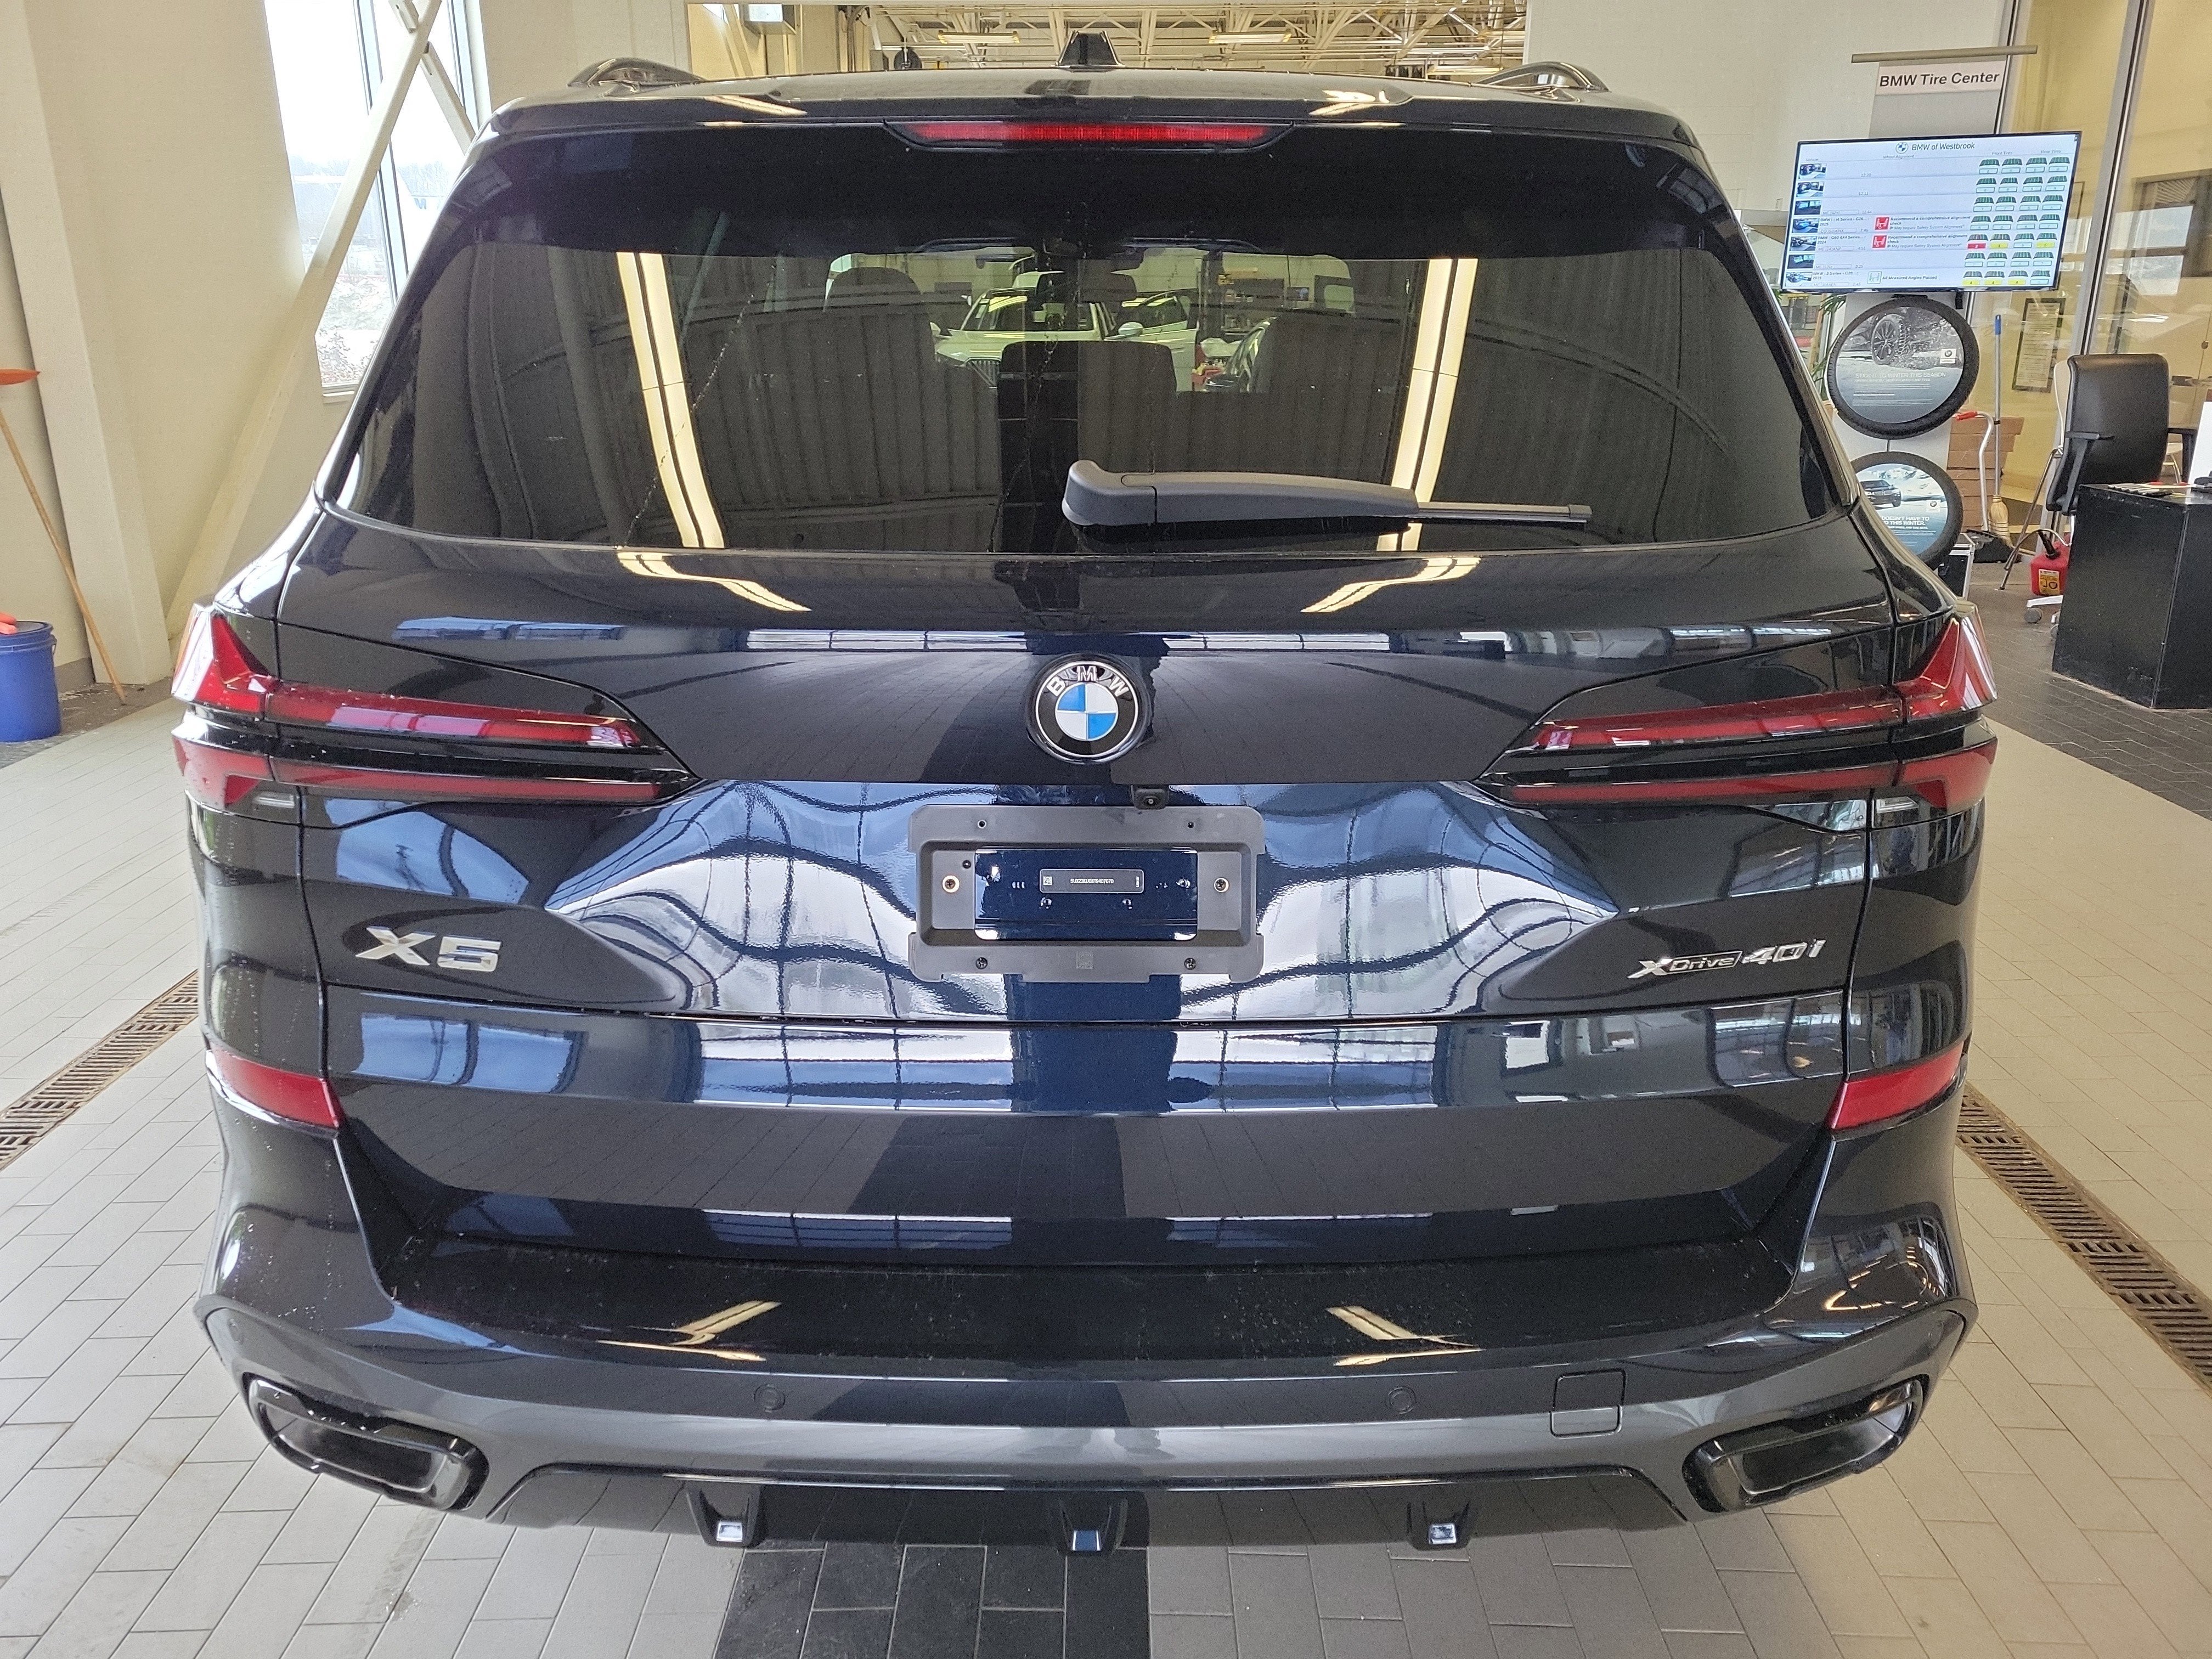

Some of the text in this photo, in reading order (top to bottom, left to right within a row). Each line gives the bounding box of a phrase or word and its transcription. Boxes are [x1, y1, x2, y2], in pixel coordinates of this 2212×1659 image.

[1880, 72, 2000, 87] BMW Tire Center
[1046, 665, 1129, 697] BMW
[355, 925, 502, 972] X5
